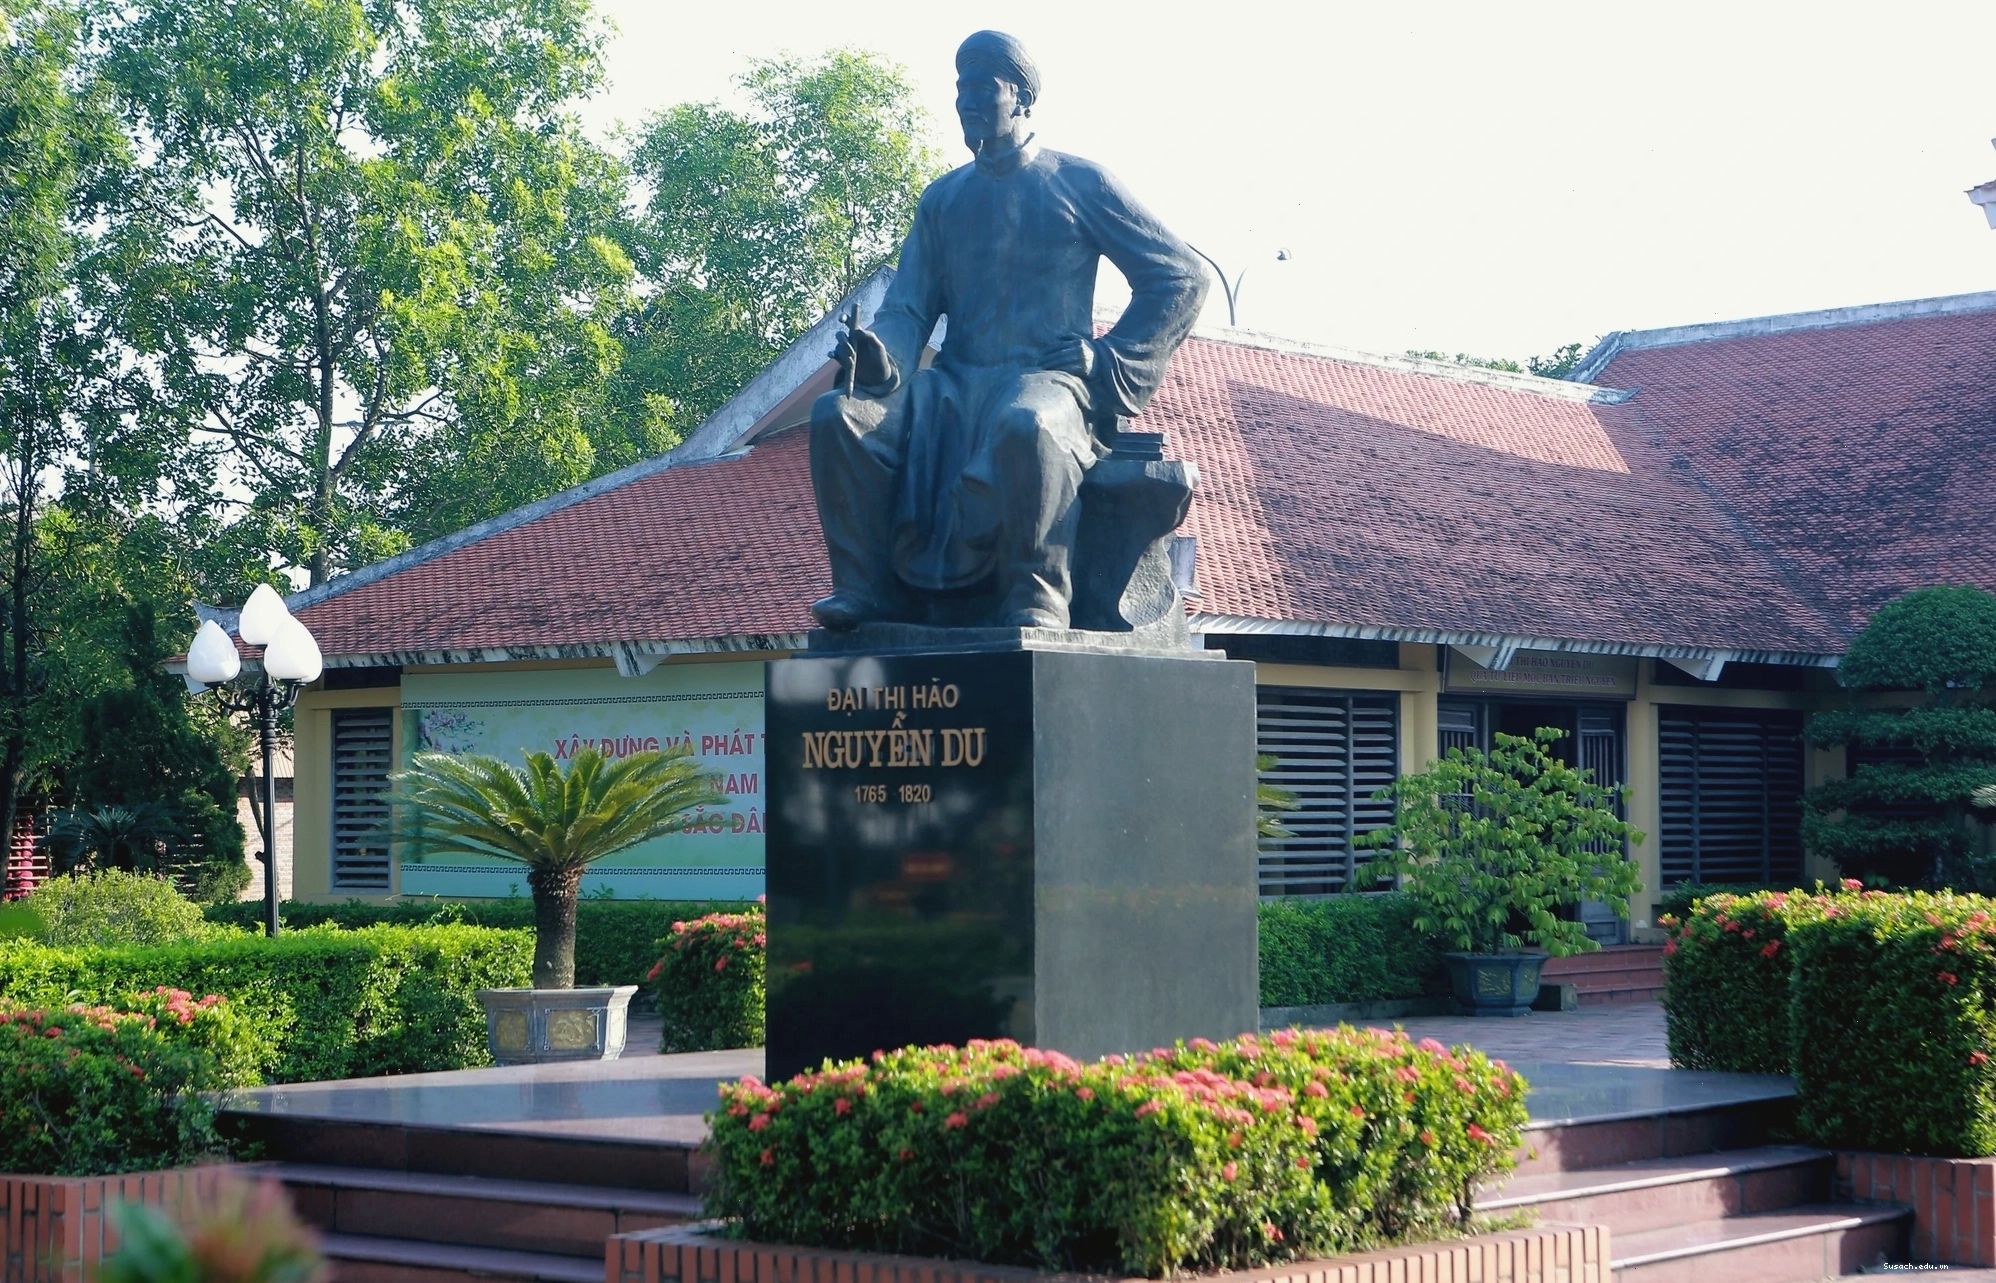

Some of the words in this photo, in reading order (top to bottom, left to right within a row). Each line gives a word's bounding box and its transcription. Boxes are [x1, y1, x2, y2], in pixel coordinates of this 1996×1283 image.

[827, 687, 862, 716] ĐẠI
[872, 686, 904, 710] THI
[912, 677, 959, 708] HÀO
[702, 727, 755, 756] PHÁT
[803, 711, 933, 768] NGUYỄN
[942, 727, 985, 767] DU
[710, 773, 758, 795] NAM
[854, 785, 887, 802] 1765
[898, 784, 931, 802] 1820
[731, 806, 765, 834] DÂ
